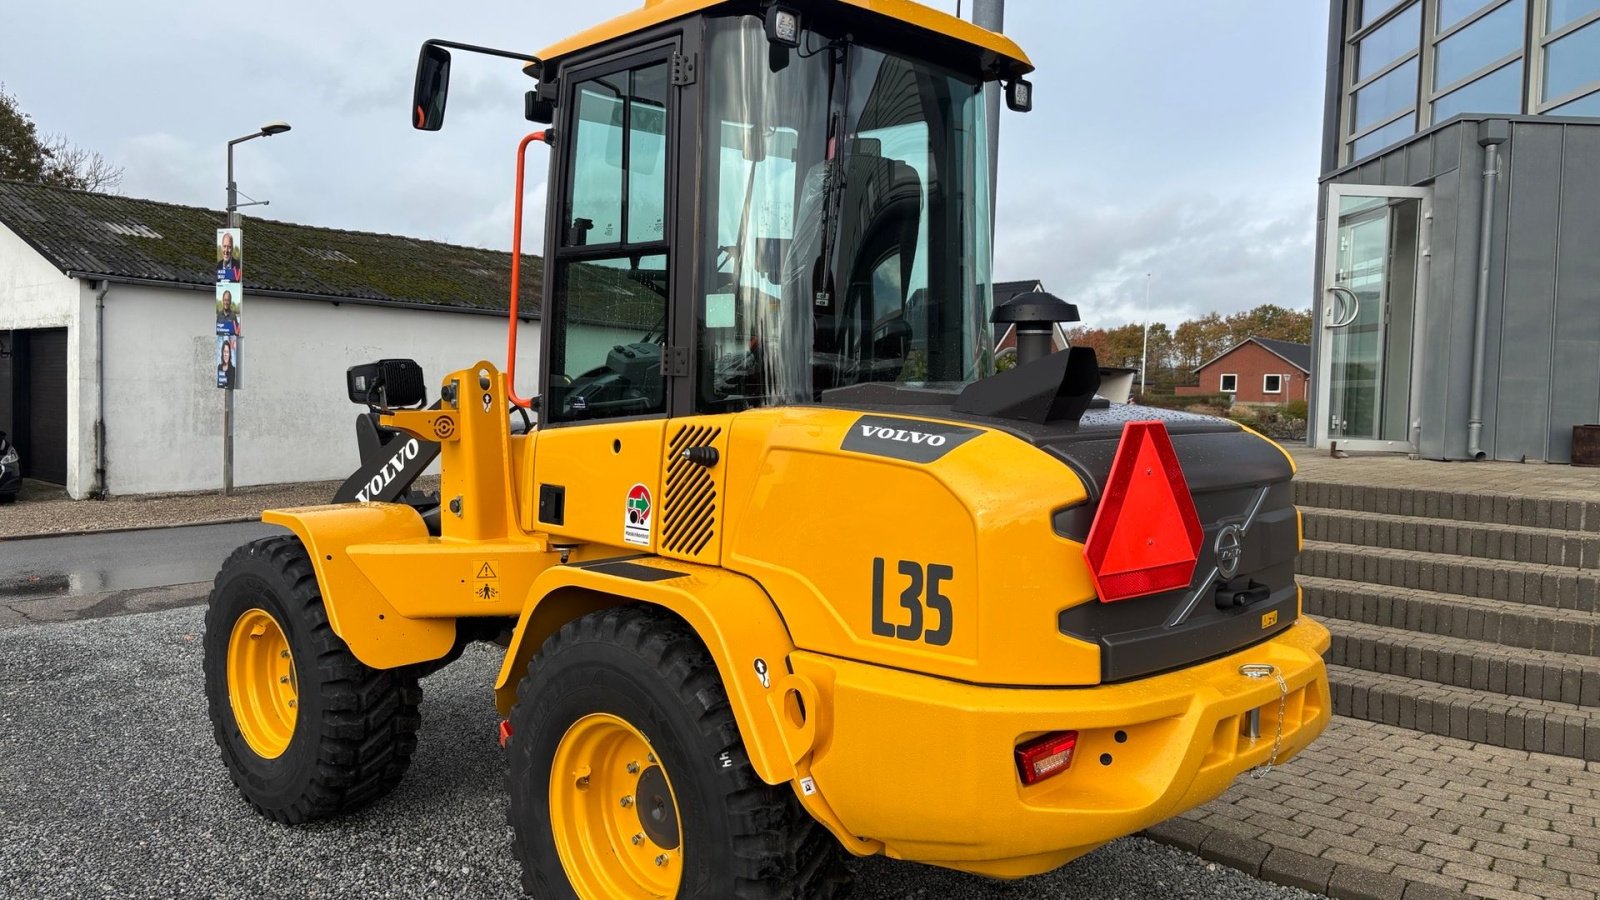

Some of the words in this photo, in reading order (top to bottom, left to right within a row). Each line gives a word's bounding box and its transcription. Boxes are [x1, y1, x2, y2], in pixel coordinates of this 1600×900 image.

[861, 425, 946, 446] VOLVO
[355, 438, 419, 503] VOLVO
[872, 557, 953, 646] L35
